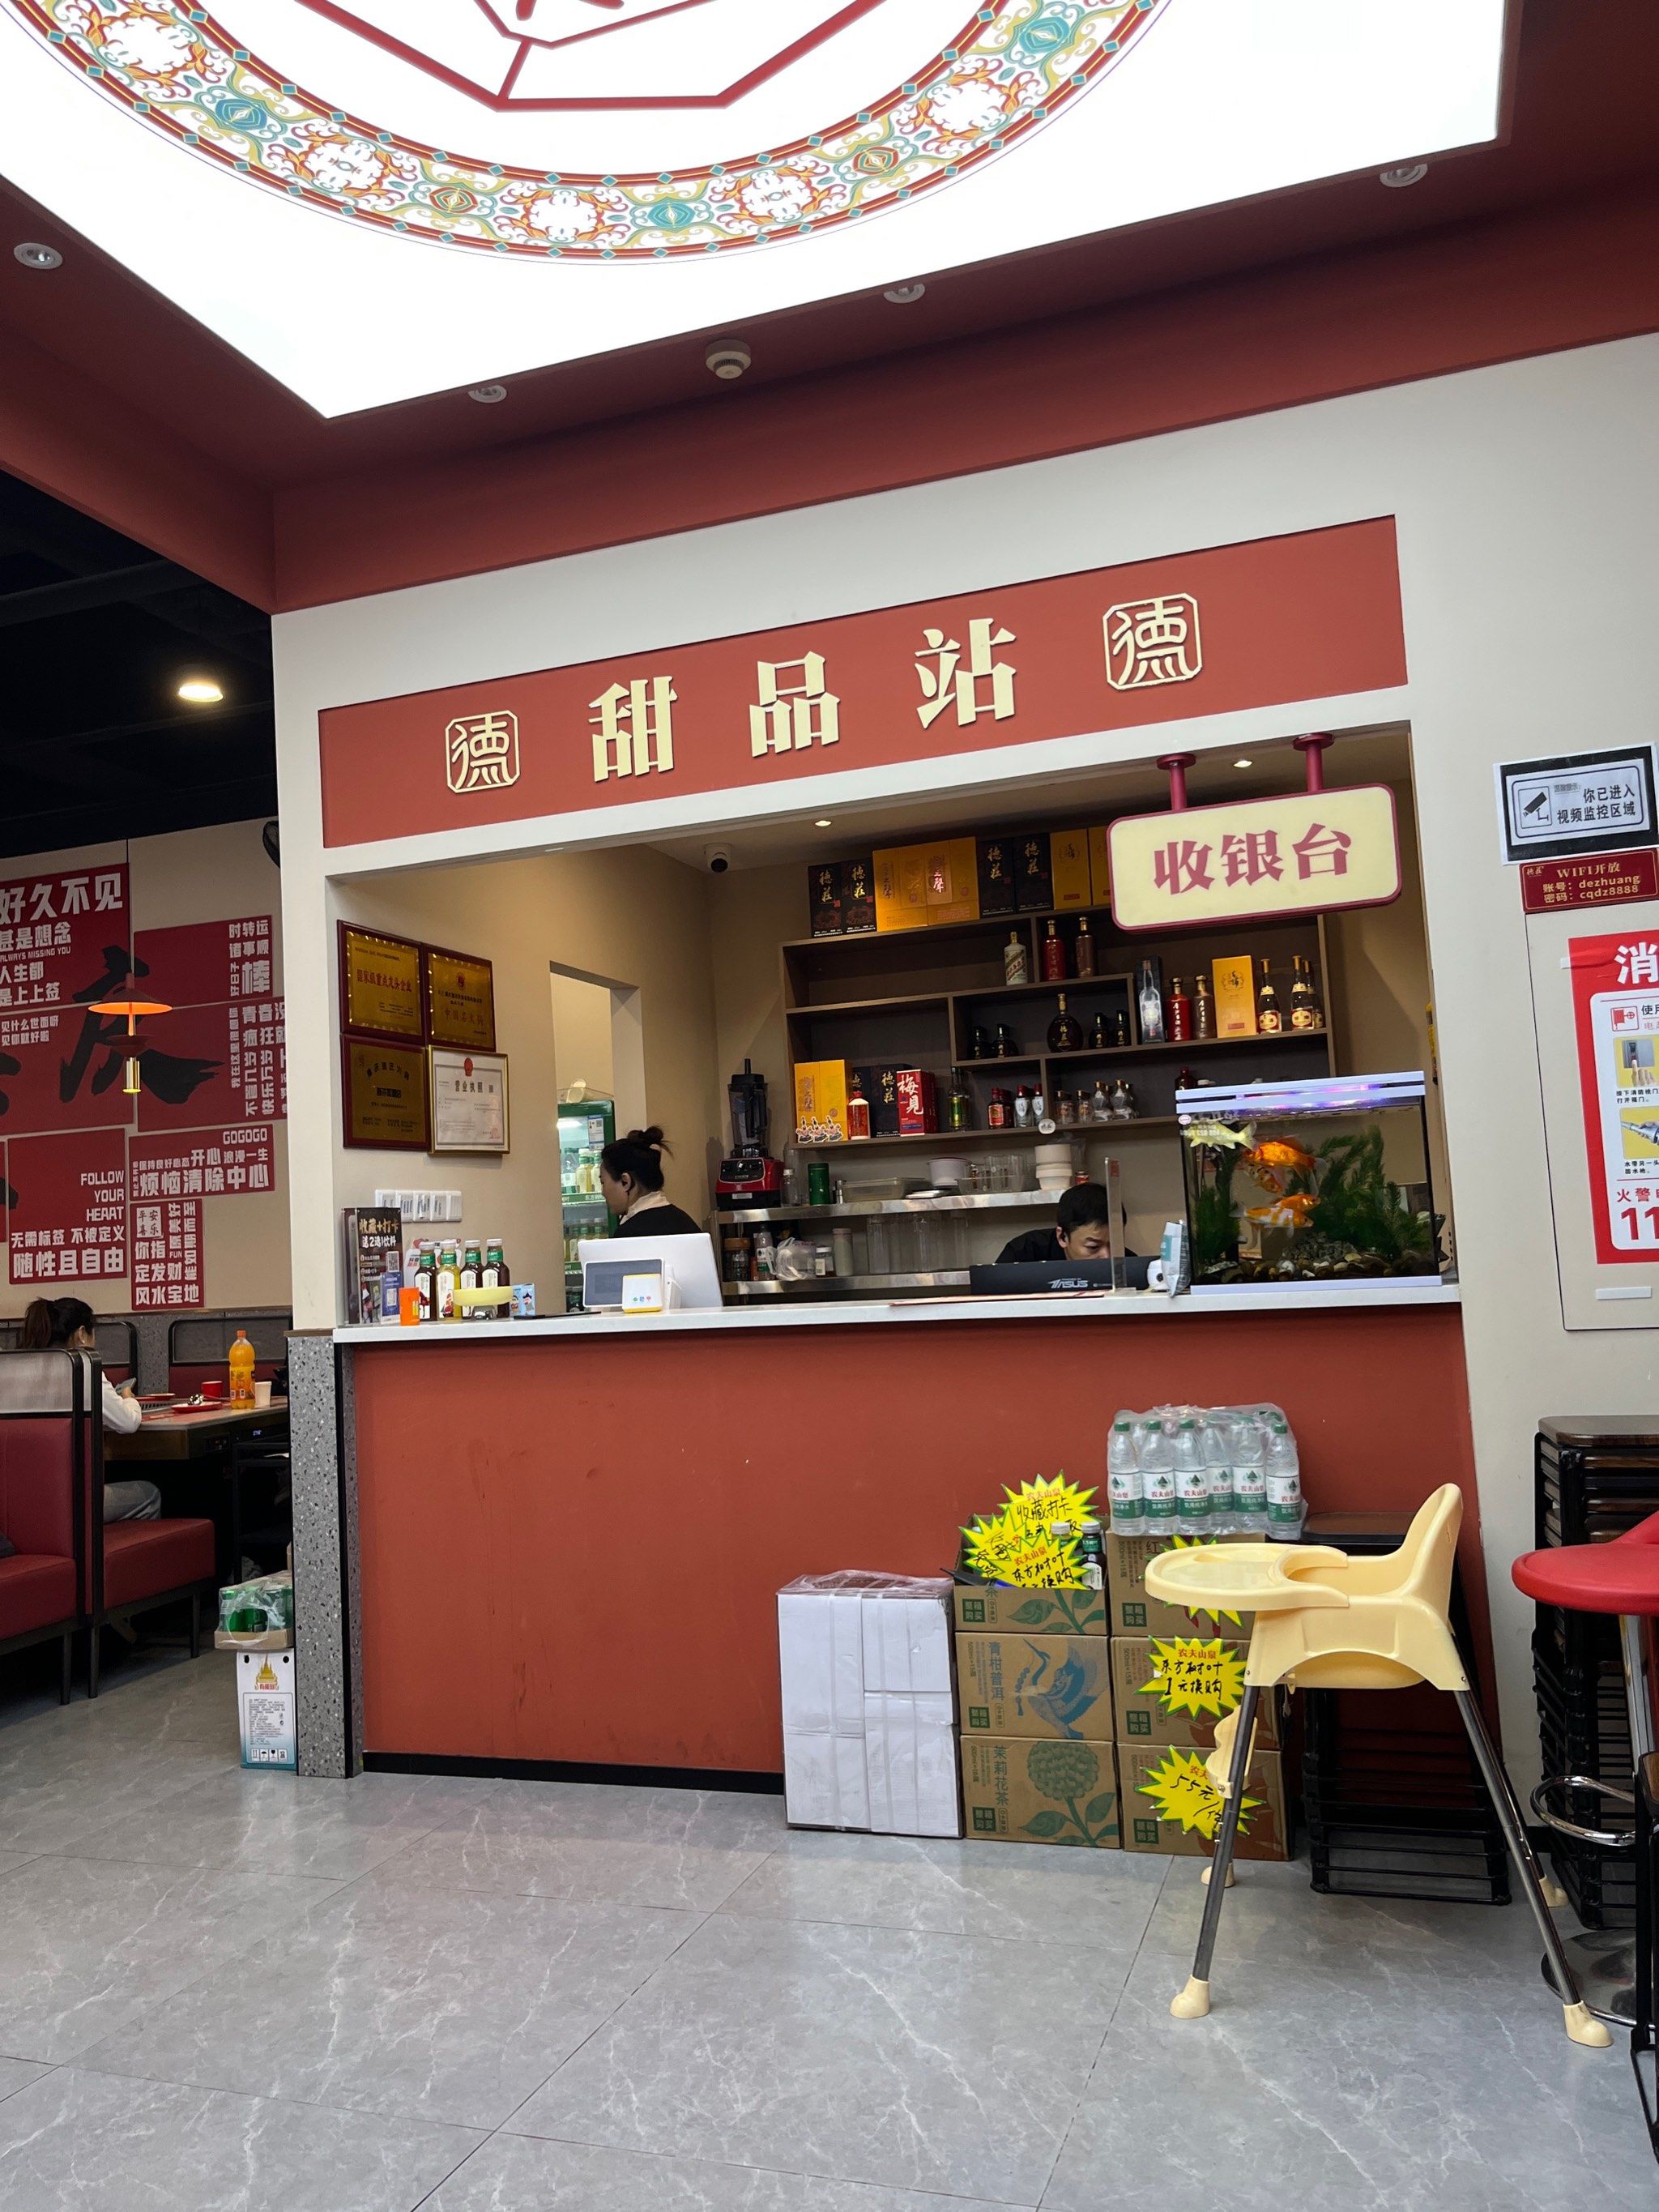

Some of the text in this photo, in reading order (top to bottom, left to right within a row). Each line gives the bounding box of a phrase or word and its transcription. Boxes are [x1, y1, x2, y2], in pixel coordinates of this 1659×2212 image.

[588, 618, 1017, 783] 甜品站
[1583, 784, 1635, 803] 你已进入
[1557, 801, 1636, 824] 视频监控区域
[1154, 823, 1351, 895] 收银台
[1557, 861, 1620, 878] WIFI开放
[1579, 874, 1640, 889] dezhuang
[1580, 885, 1639, 899] cqdz8888
[0, 873, 122, 925] 好久不见
[0, 921, 71, 952] 甚是想念
[229, 920, 269, 938] 时转运
[0, 946, 71, 963] ALWAYS MISSING YOU
[229, 939, 269, 959] 诸事顺
[0, 961, 44, 984] 人生都
[230, 961, 240, 997] 好日子
[0, 982, 60, 1006] 是上上签
[245, 1052, 258, 1117] 不管几岁
[261, 1049, 275, 1115] 快乐万岁
[223, 1128, 267, 1145] GOGOGO
[139, 1147, 268, 1171] 保持良好心态 开心 浪漫一生
[81, 1170, 124, 1185] FOLLOW
[140, 1164, 269, 1196] 烦恼清除中心
[95, 1189, 124, 1202] YOUR
[11, 1225, 126, 1249] 无需标签 不被定义
[135, 1241, 166, 1260] 你指
[13, 1247, 124, 1279] 随性且自由
[135, 1262, 182, 1283] 定发财
[136, 1283, 199, 1305] 风水宝地
[1047, 1279, 1089, 1288] ASUS
[1017, 1498, 1073, 1521] 收藏打卡
[1013, 1551, 1064, 1581] 东方树叶
[1014, 1547, 1047, 1566] 农夫山泉
[1021, 1570, 1074, 1588] 换购
[1178, 1648, 1217, 1659] 农夫山泉
[989, 1642, 1004, 1700] 青柑普洱
[1162, 1659, 1223, 1676] 东方树叶
[1164, 1677, 1222, 1701] 1元换购
[994, 1744, 1009, 1805] 茉莉花茶
